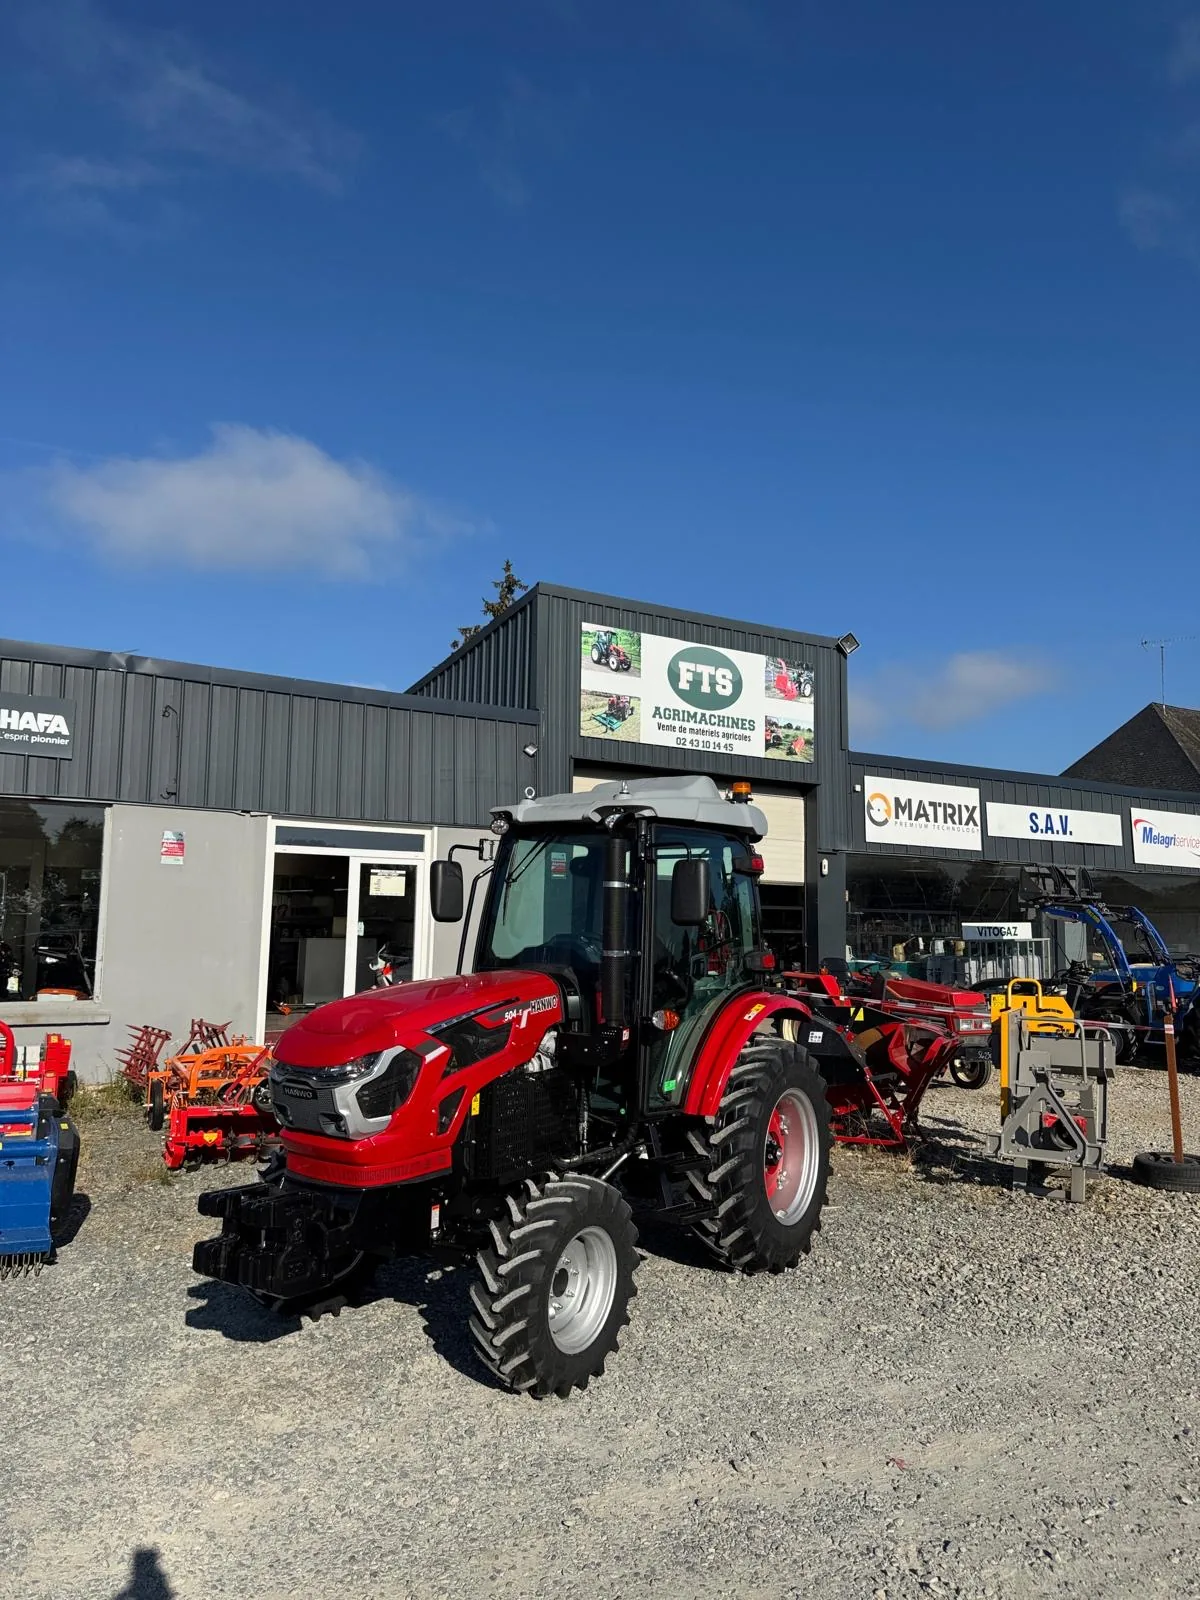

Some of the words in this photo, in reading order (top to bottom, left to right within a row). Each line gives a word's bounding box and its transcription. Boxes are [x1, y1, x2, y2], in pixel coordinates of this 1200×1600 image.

[677, 660, 733, 697] FTS
[0, 708, 70, 736] HAFA
[652, 706, 756, 731] AGRIMACHINES
[0, 731, 30, 742] 'esprit
[30, 735, 70, 745] pionnier
[657, 722, 677, 733] Vente
[678, 725, 687, 734] de
[721, 731, 752, 742] agricoles
[675, 737, 687, 746] 02
[688, 738, 700, 748] 43
[701, 740, 711, 749] 10
[712, 741, 721, 750] 14
[723, 743, 734, 752] 45
[894, 796, 979, 828] MATRIX
[894, 820, 929, 829] PREMIUM
[1029, 812, 1073, 836] S.A.V.
[530, 995, 559, 1014] HANWO
